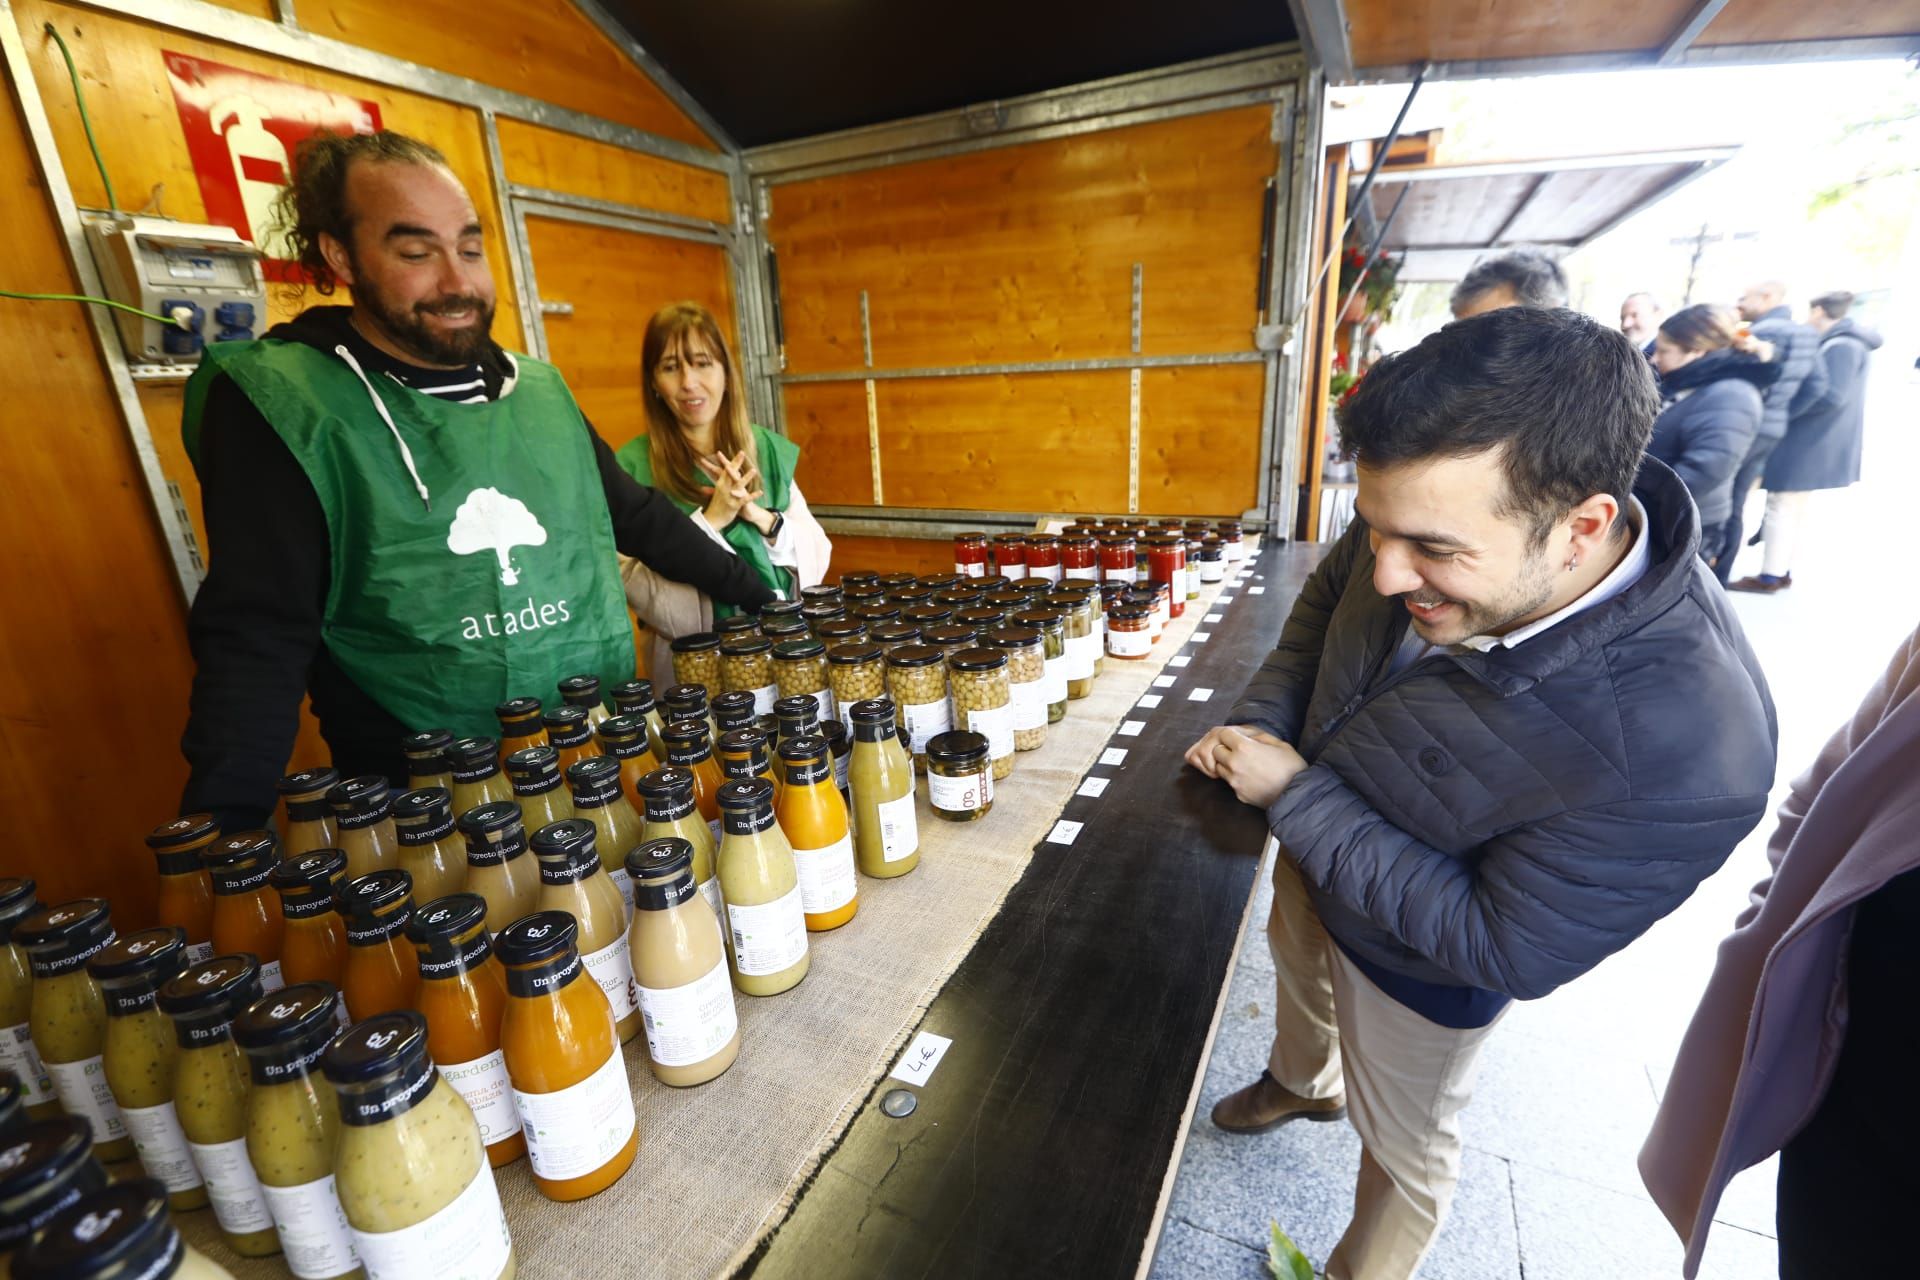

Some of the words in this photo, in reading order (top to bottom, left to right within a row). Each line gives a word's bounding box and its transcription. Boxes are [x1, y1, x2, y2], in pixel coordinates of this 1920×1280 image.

[460, 596, 570, 640] atades
[554, 863, 590, 879] proyecto
[664, 887, 678, 900] Un
[51, 944, 102, 970] proyecto
[421, 957, 462, 973] proyecto
[463, 941, 488, 962] social
[533, 976, 550, 988] Un
[119, 998, 136, 1008] Un
[190, 1028, 208, 1040] Un
[906, 1045, 938, 1073] 4€
[265, 1065, 284, 1077] Un
[360, 1103, 380, 1116] Un
